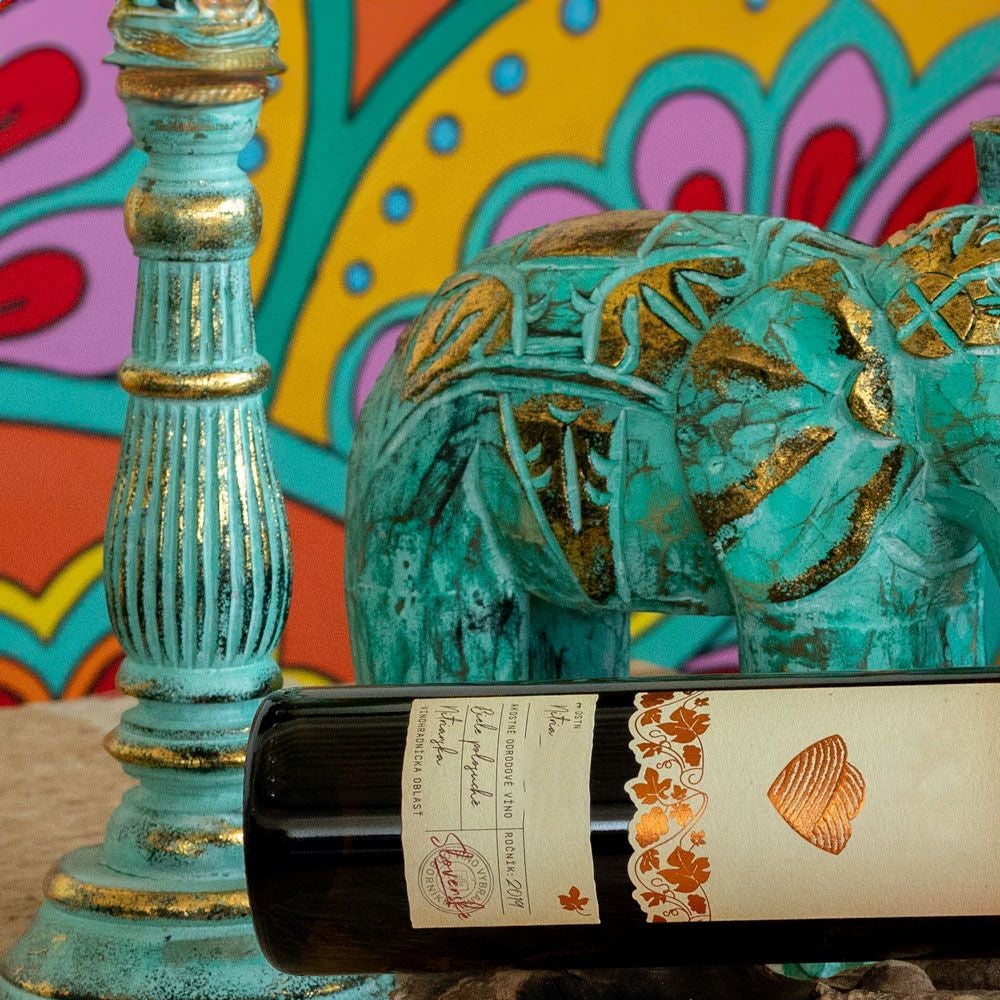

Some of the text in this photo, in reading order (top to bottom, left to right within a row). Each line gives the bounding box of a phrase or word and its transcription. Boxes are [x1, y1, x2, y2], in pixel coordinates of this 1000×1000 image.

[470, 705, 498, 735] Biele
[412, 777, 424, 817] OBLASŤ
[503, 703, 519, 819] AKOSTNÉ ODRODOVÉ VÍNO
[430, 832, 486, 920] Slovenské
[504, 832, 526, 909] ROČNÍK: 2019
